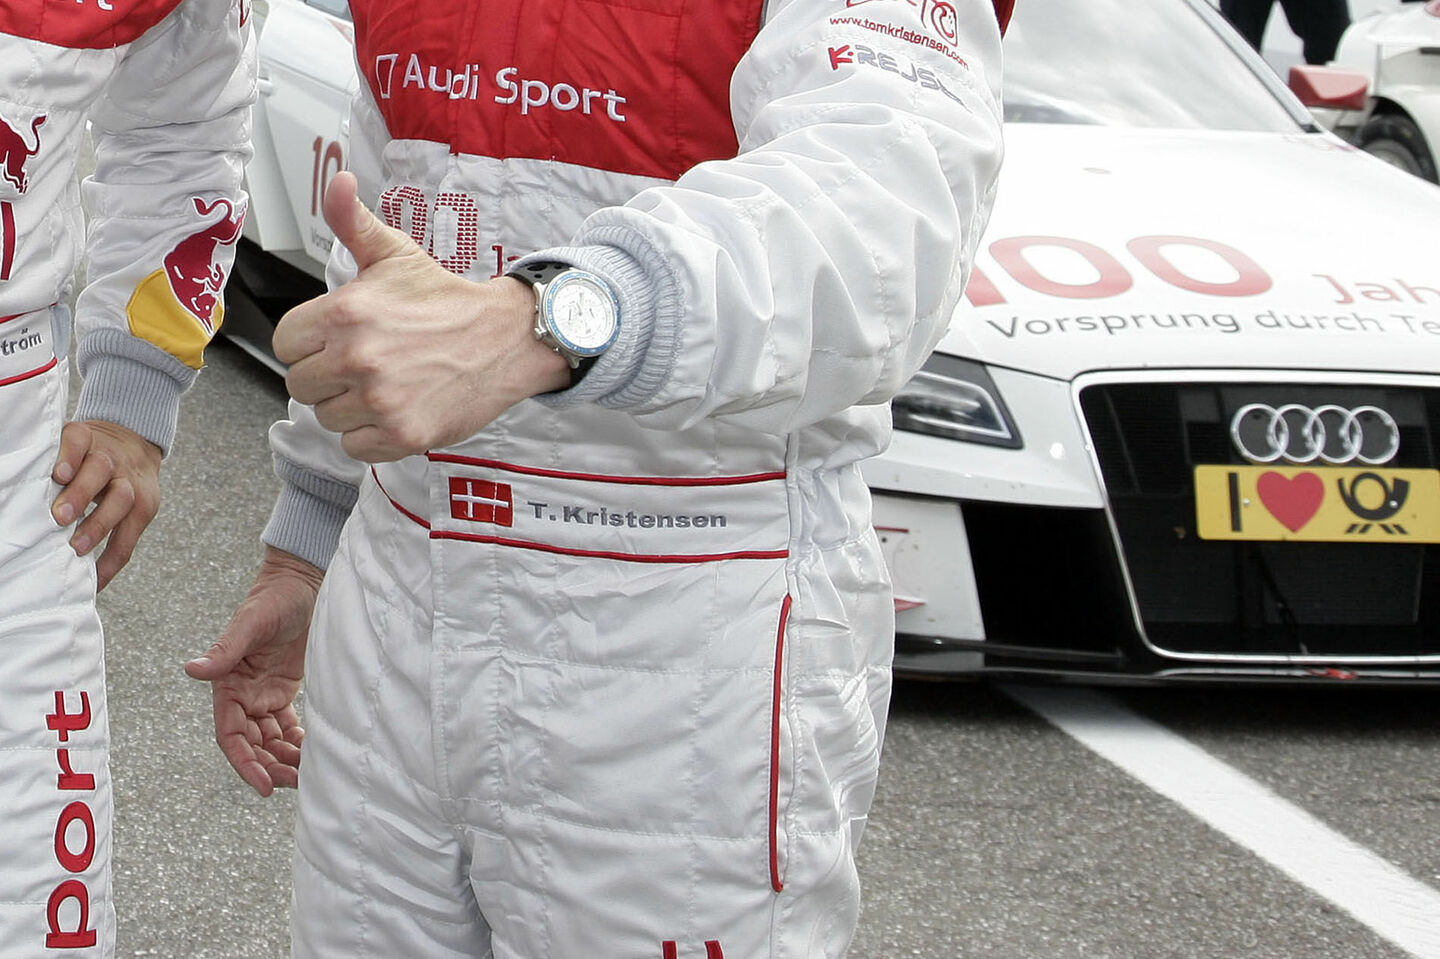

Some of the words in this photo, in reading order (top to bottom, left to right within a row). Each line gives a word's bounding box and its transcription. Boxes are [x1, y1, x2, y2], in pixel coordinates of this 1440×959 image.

[402, 53, 480, 101] Audi
[494, 66, 628, 123] Sport
[986, 308, 1243, 339] Vorsprung
[1245, 309, 1386, 333] durch
[526, 500, 557, 522] T.
[562, 505, 728, 529] Kristensen
